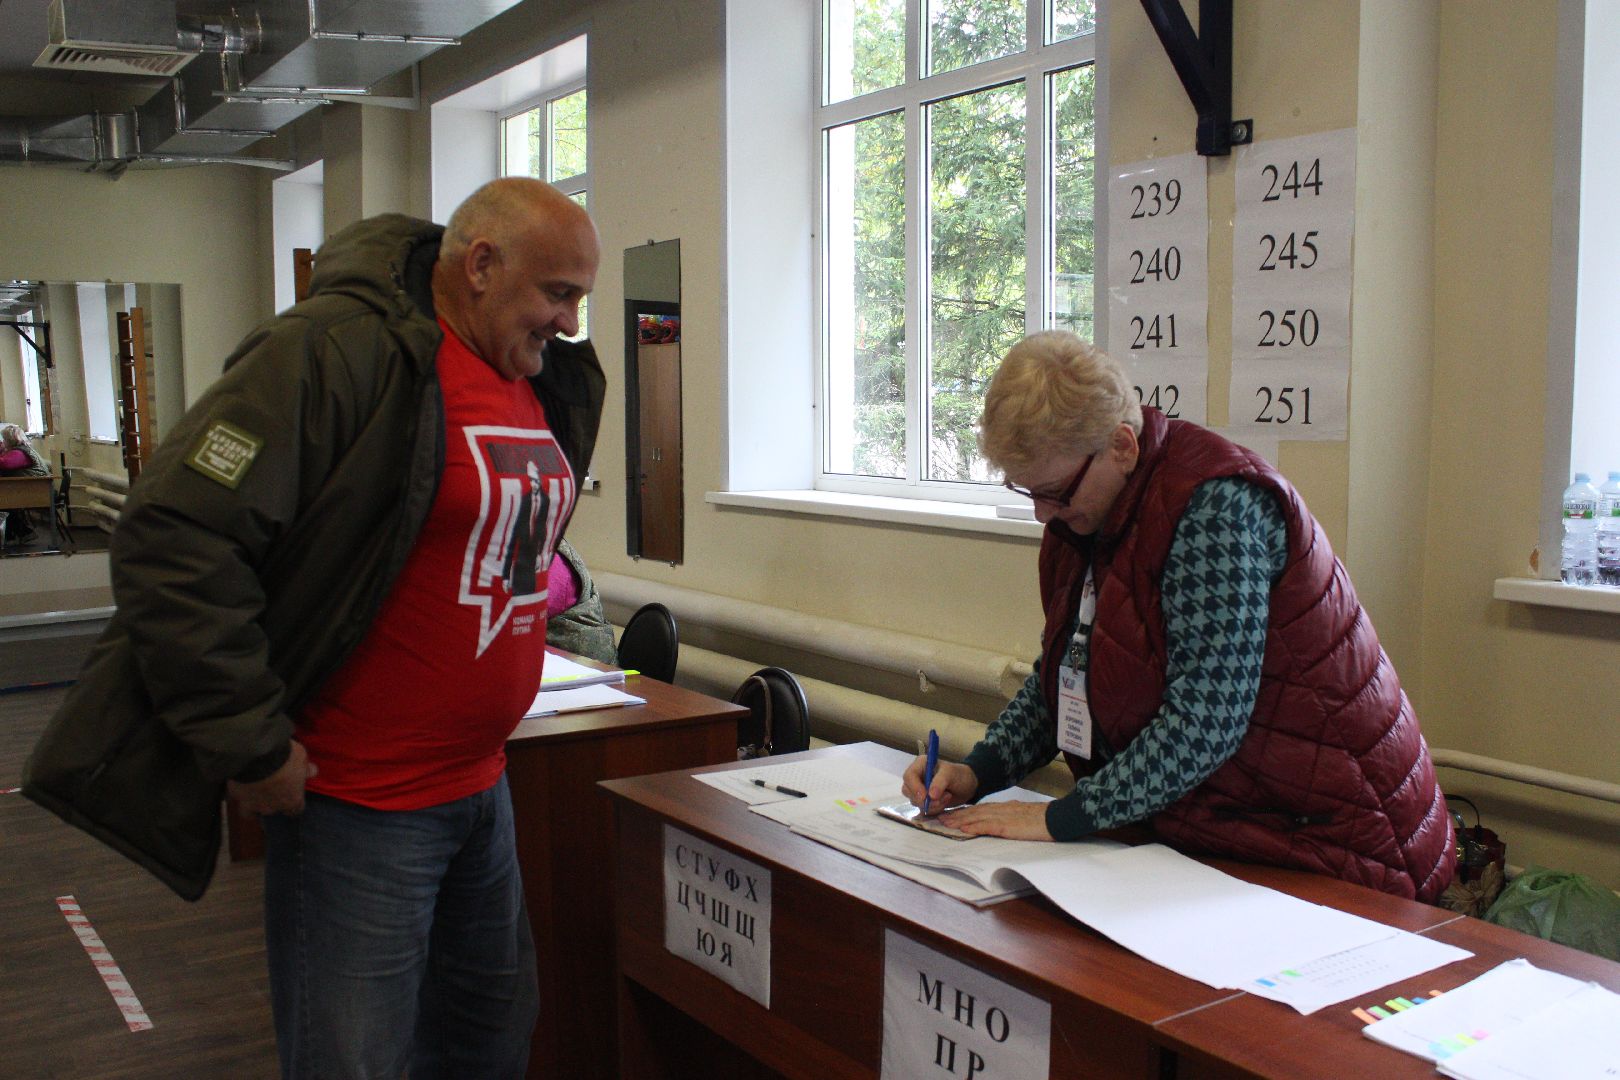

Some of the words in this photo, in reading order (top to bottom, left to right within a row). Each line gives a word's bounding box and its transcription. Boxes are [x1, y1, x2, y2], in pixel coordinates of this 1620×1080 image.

[1130, 179, 1182, 220] 239
[1261, 158, 1323, 202] 244
[1130, 246, 1182, 284] 240
[1259, 231, 1319, 271] 245
[1130, 313, 1179, 349] 241
[1257, 309, 1319, 347] 250
[1254, 386, 1312, 425] 251
